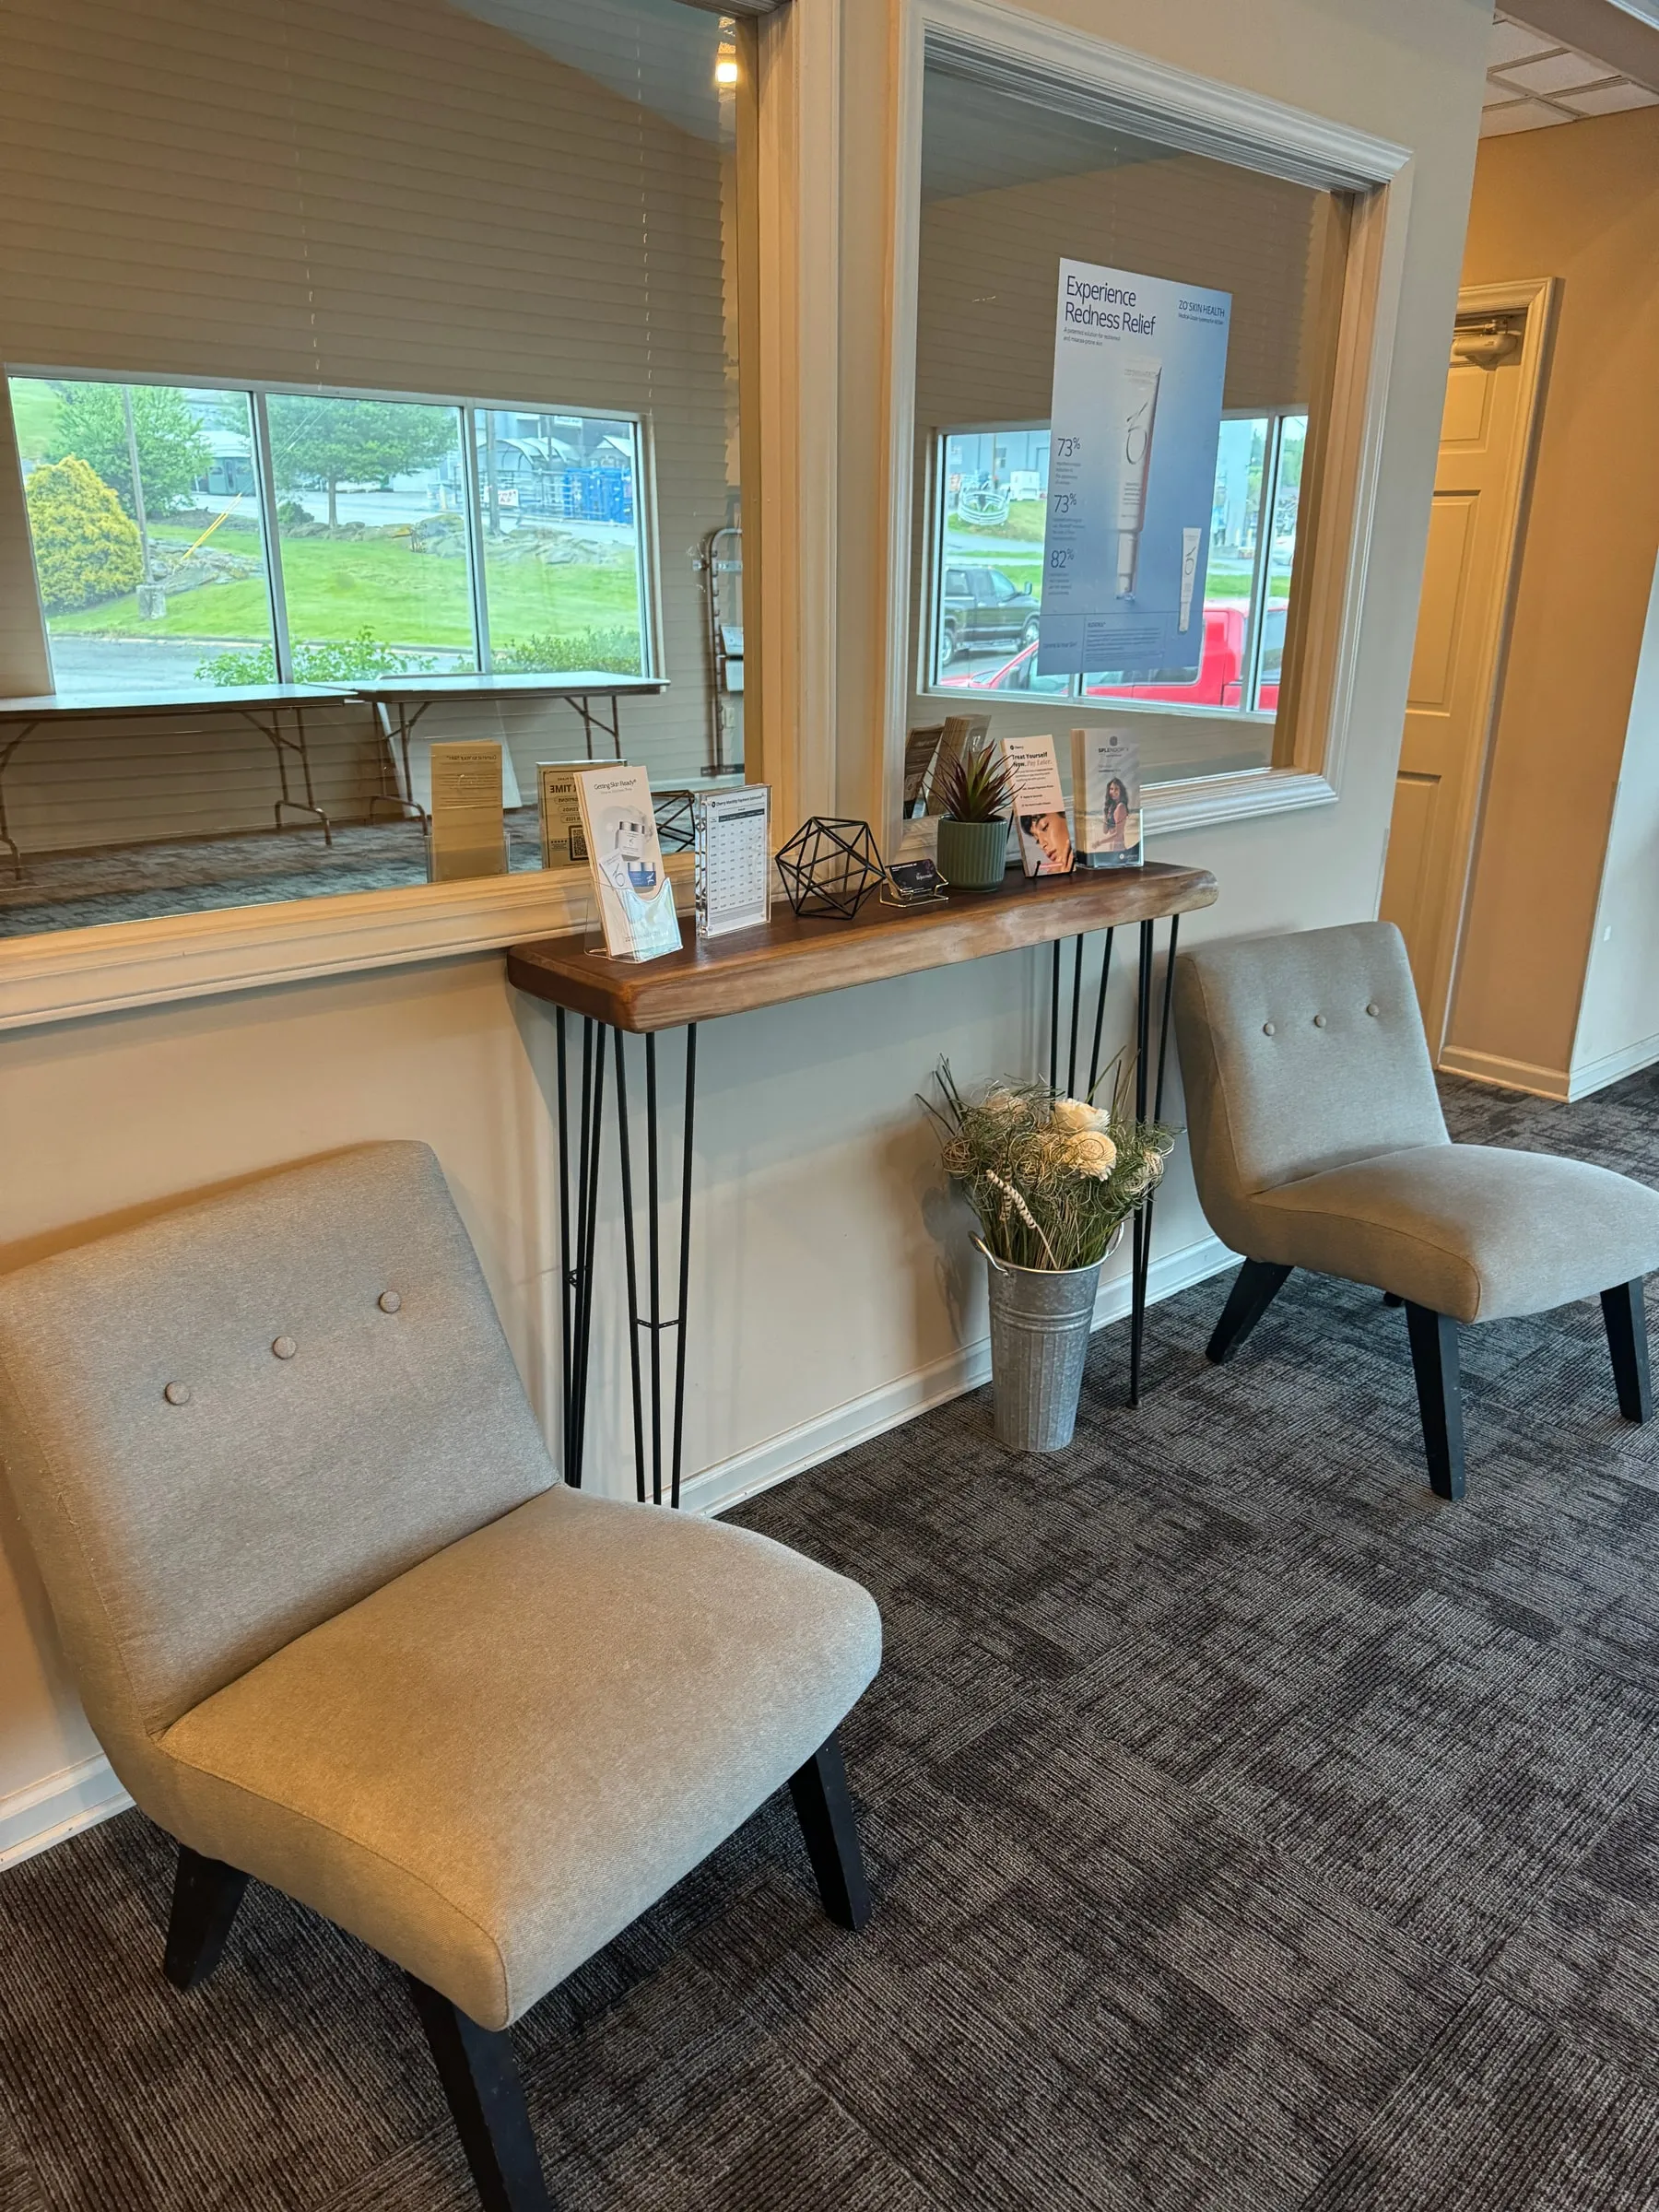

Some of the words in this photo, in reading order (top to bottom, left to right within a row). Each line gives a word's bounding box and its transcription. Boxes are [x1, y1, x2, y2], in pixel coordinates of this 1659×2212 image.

[1066, 275, 1136, 307] Experience
[1065, 301, 1120, 330] Redness
[1122, 312, 1156, 335] Relief
[1189, 301, 1202, 313] SKIN
[1203, 304, 1225, 317] HEALTH
[1057, 437, 1081, 458] 73%
[1053, 493, 1077, 514] 73%
[1051, 548, 1075, 569] 82%
[1026, 751, 1048, 759] Yourself
